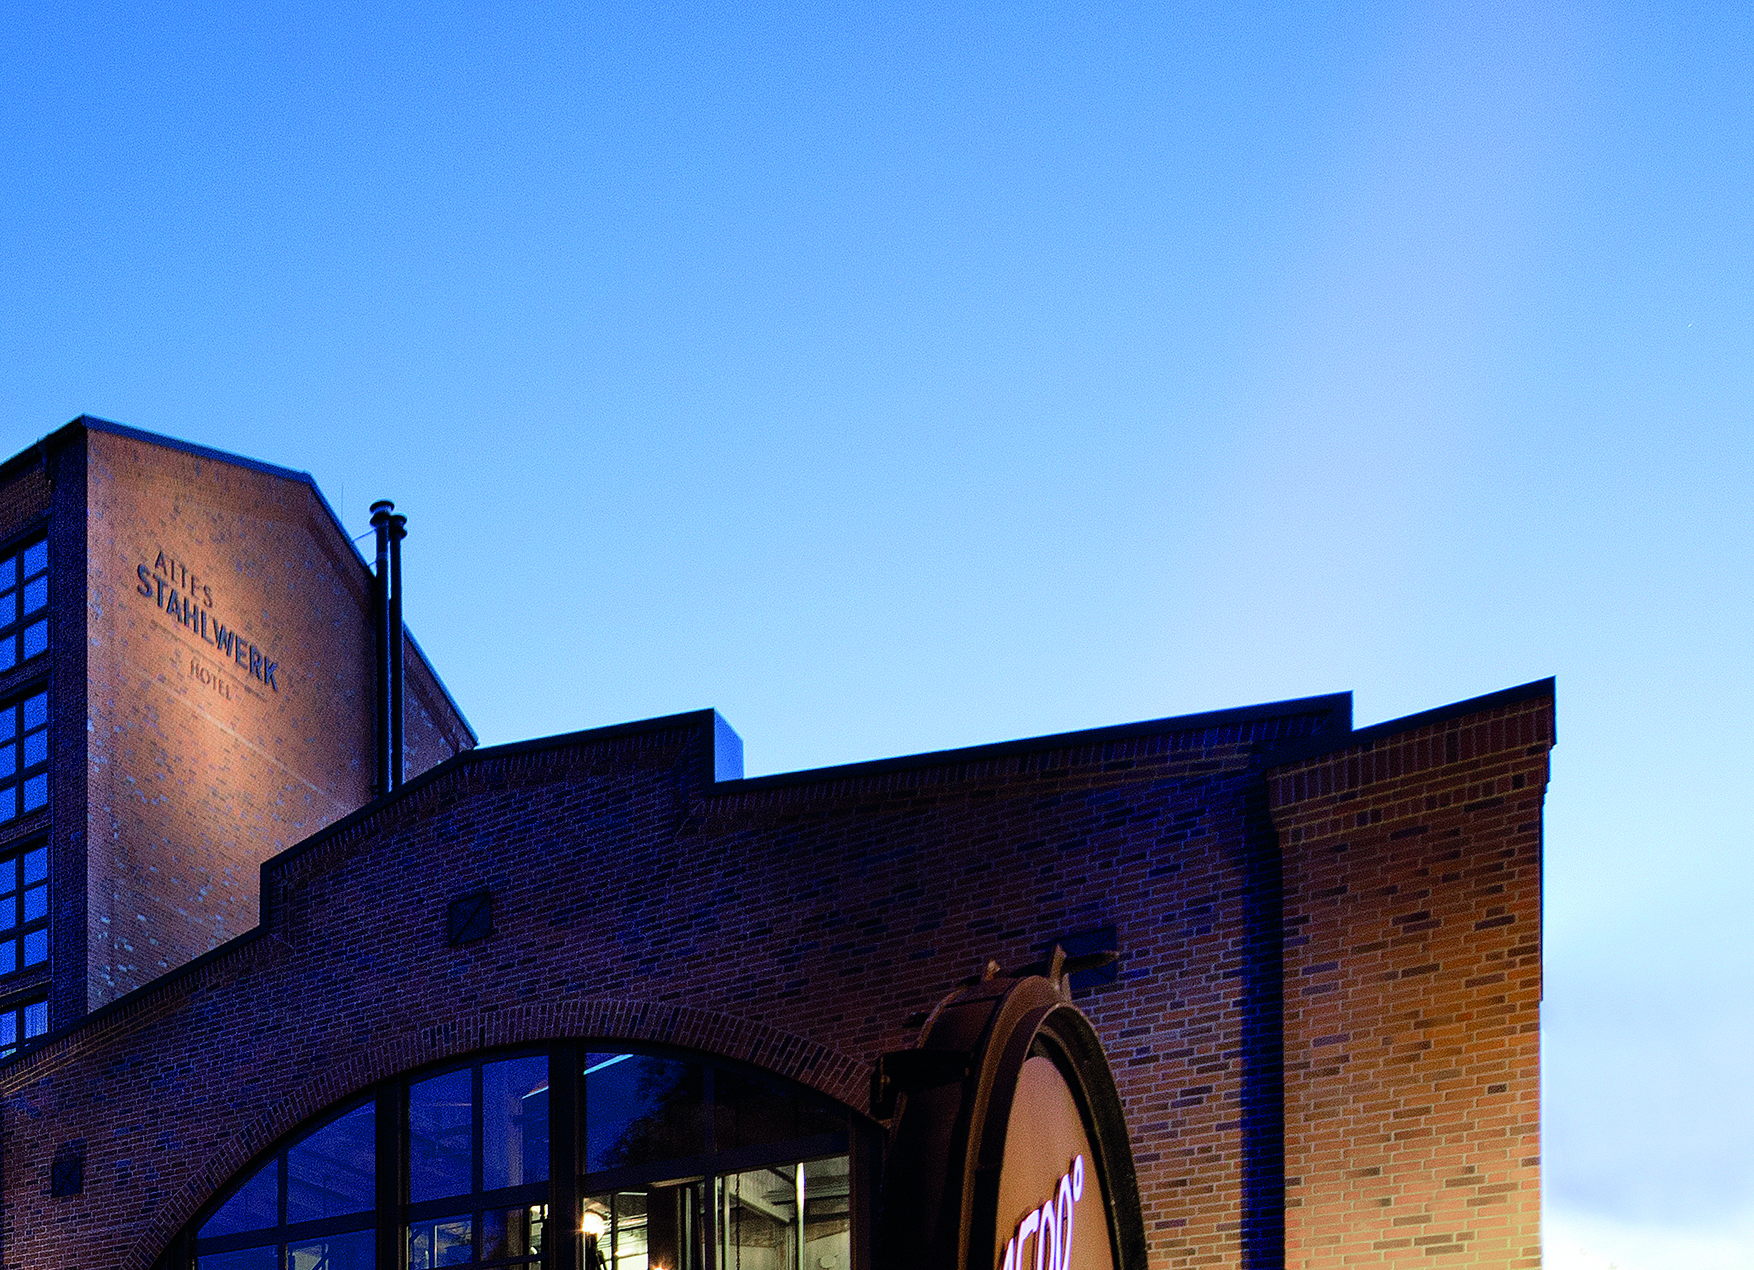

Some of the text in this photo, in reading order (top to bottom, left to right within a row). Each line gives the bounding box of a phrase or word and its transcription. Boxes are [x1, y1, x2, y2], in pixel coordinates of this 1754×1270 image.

[154, 550, 214, 609] ALTES
[137, 563, 279, 693] STAHLWERK
[190, 656, 232, 701] HOTEL
